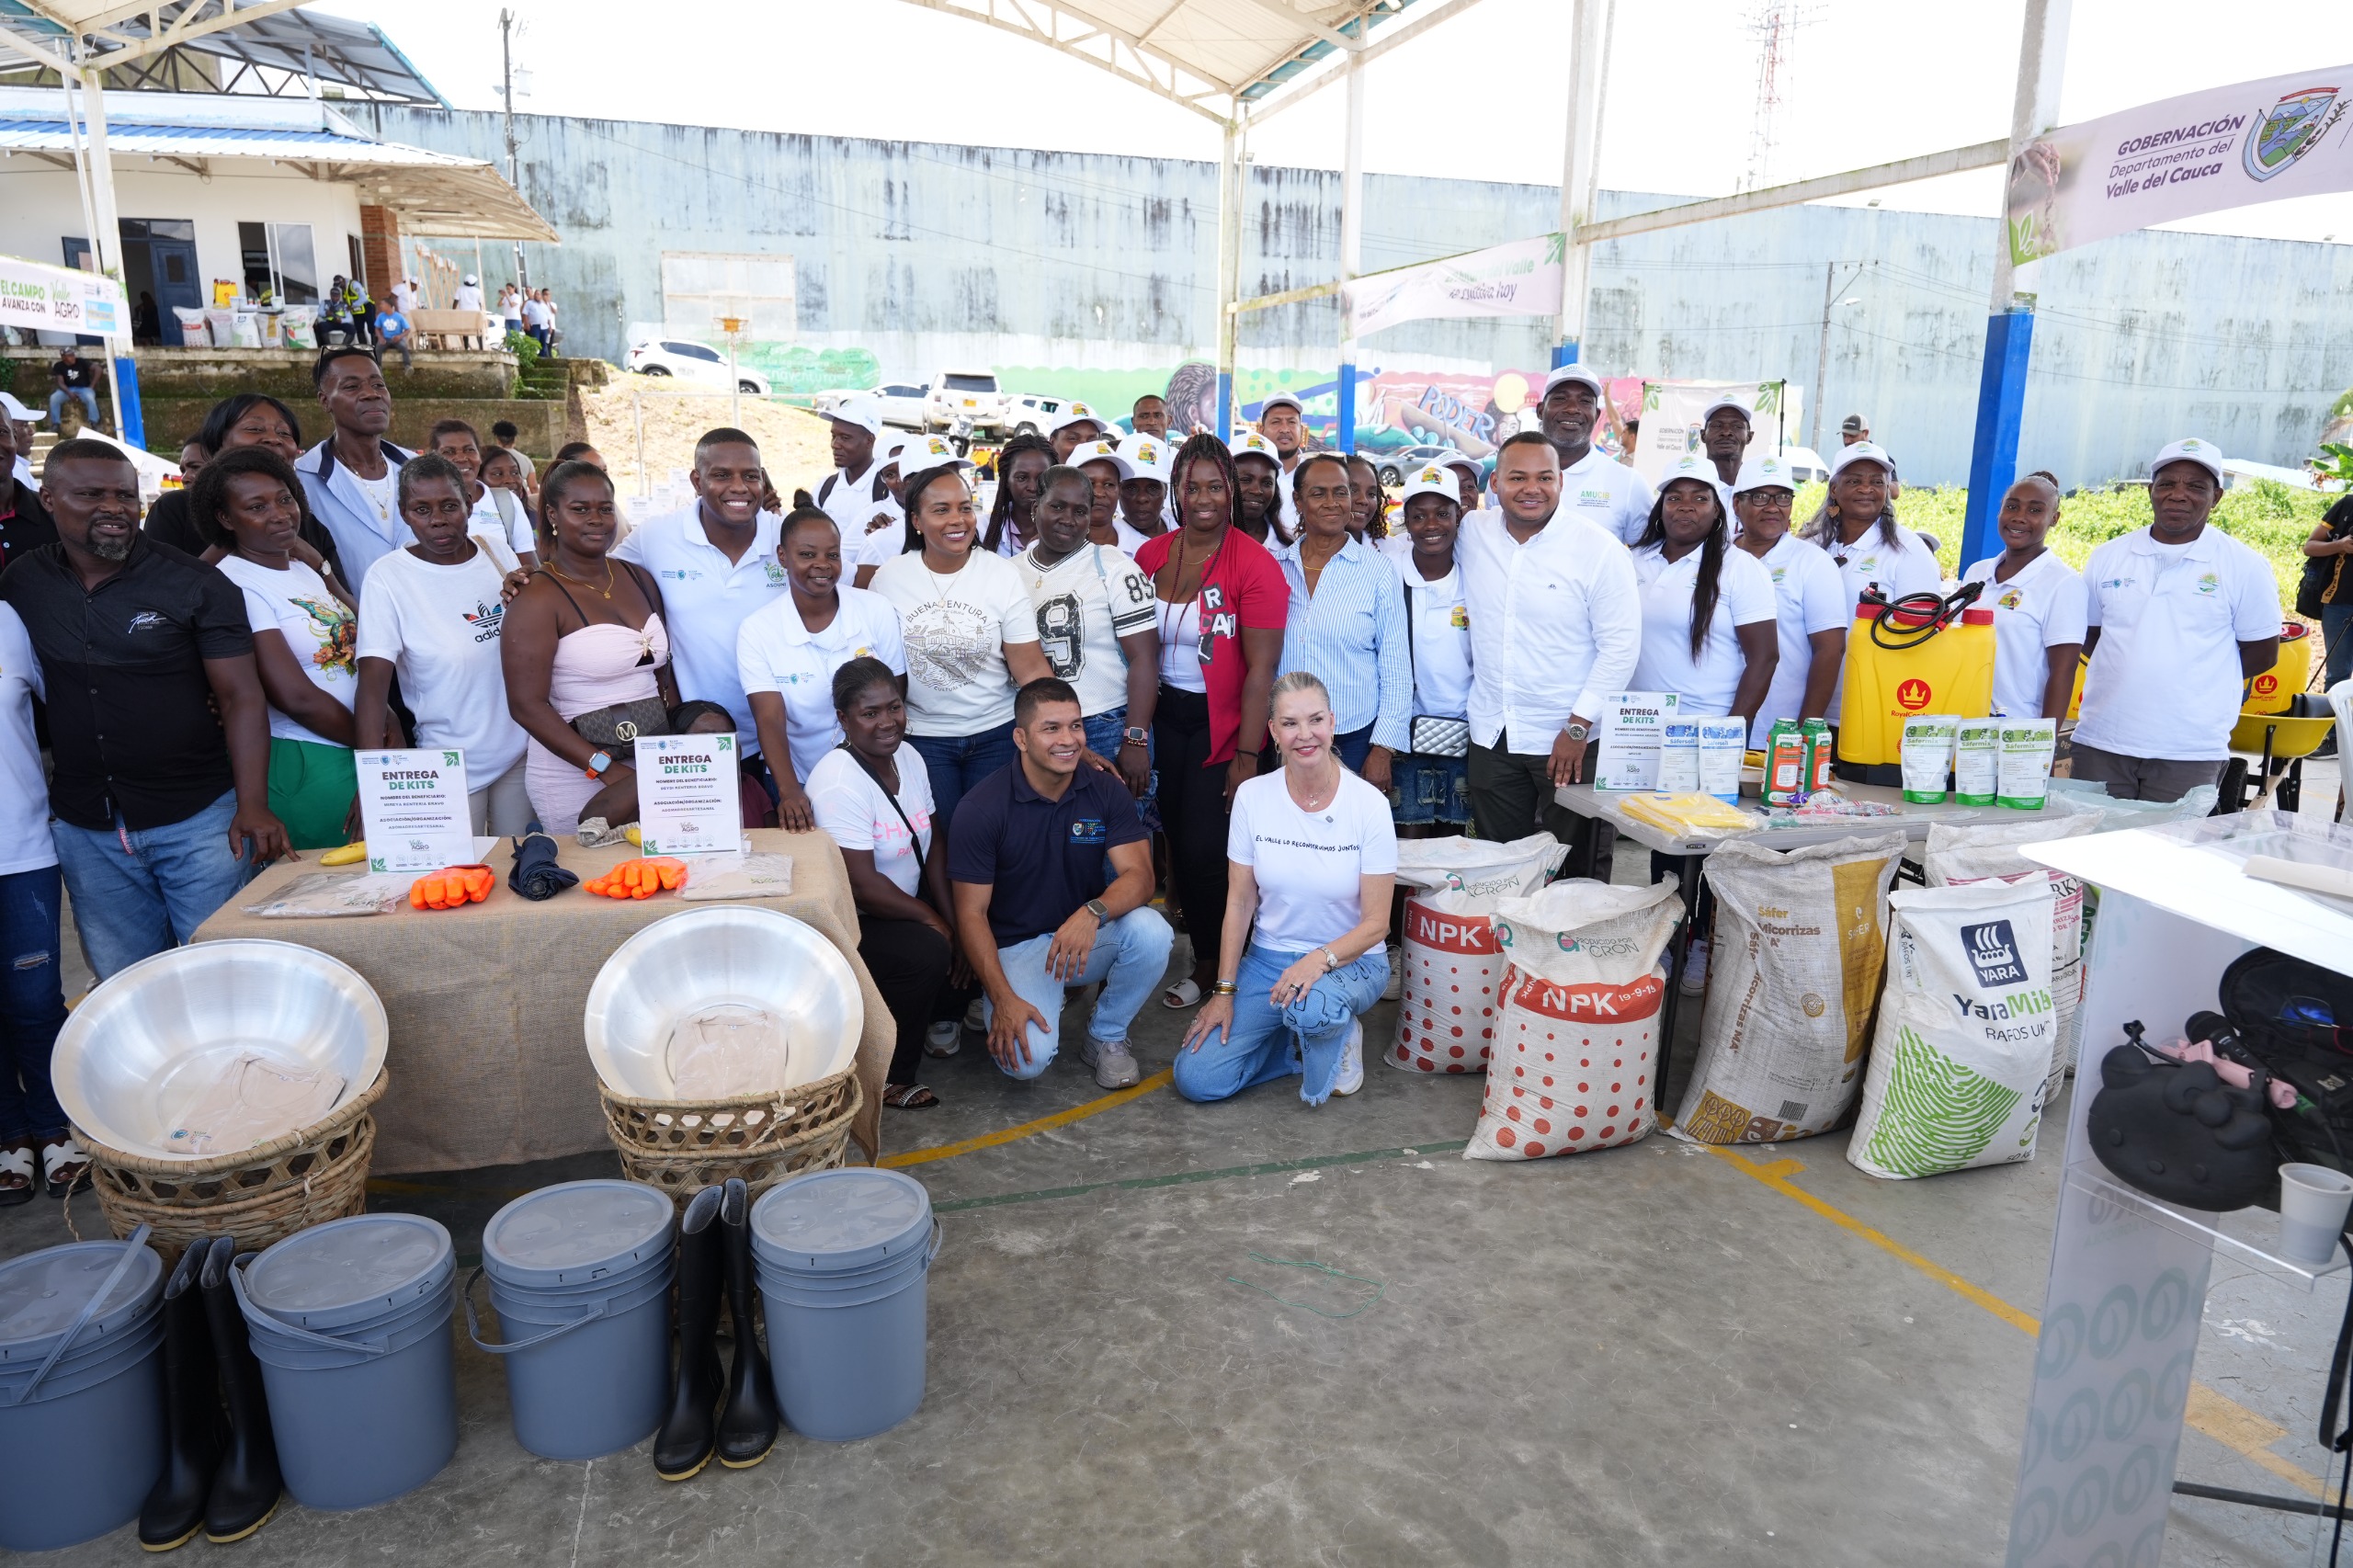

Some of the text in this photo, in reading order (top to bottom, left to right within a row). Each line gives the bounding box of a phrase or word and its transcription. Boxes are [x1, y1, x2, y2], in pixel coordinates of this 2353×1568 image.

[2117, 114, 2246, 156] GOBERNACIÓN
[2109, 138, 2234, 178] Departamento del
[2106, 162, 2222, 200] Valle del Cauca
[1506, 257, 1534, 275] Valle
[1, 279, 45, 301] EL CAMPO
[51, 279, 71, 301] Valle
[1496, 280, 1518, 301] hoy
[2, 297, 46, 313] AVANZA CON
[55, 301, 80, 319] AGRO
[1418, 384, 1495, 443] PODER
[1124, 574, 1155, 604] 89
[1204, 586, 1222, 608] R
[906, 599, 987, 624] BUENAENTURA
[475, 627, 500, 643] adid
[1036, 590, 1086, 682] 9
[1620, 708, 1660, 716] ENTREGA
[659, 755, 711, 765] ENTREGA
[665, 765, 708, 774] DE KITS
[382, 770, 439, 780] ENTREGA
[390, 780, 435, 790] DE KITS
[1292, 840, 1336, 851] RECONSTRUIMOS
[1757, 905, 1789, 919] Sáfer
[1419, 915, 1483, 949] NPK
[1757, 922, 1821, 936] Micorrizas
[1576, 937, 1617, 947] PRODUCIDO
[1901, 941, 1911, 965] RAFOS
[1979, 965, 2020, 983] YARA
[1521, 979, 1537, 999] NPK
[1736, 970, 1762, 1028] icorrizas
[1542, 987, 1619, 1017] NPK
[1985, 1027, 2029, 1042] RAFOS
